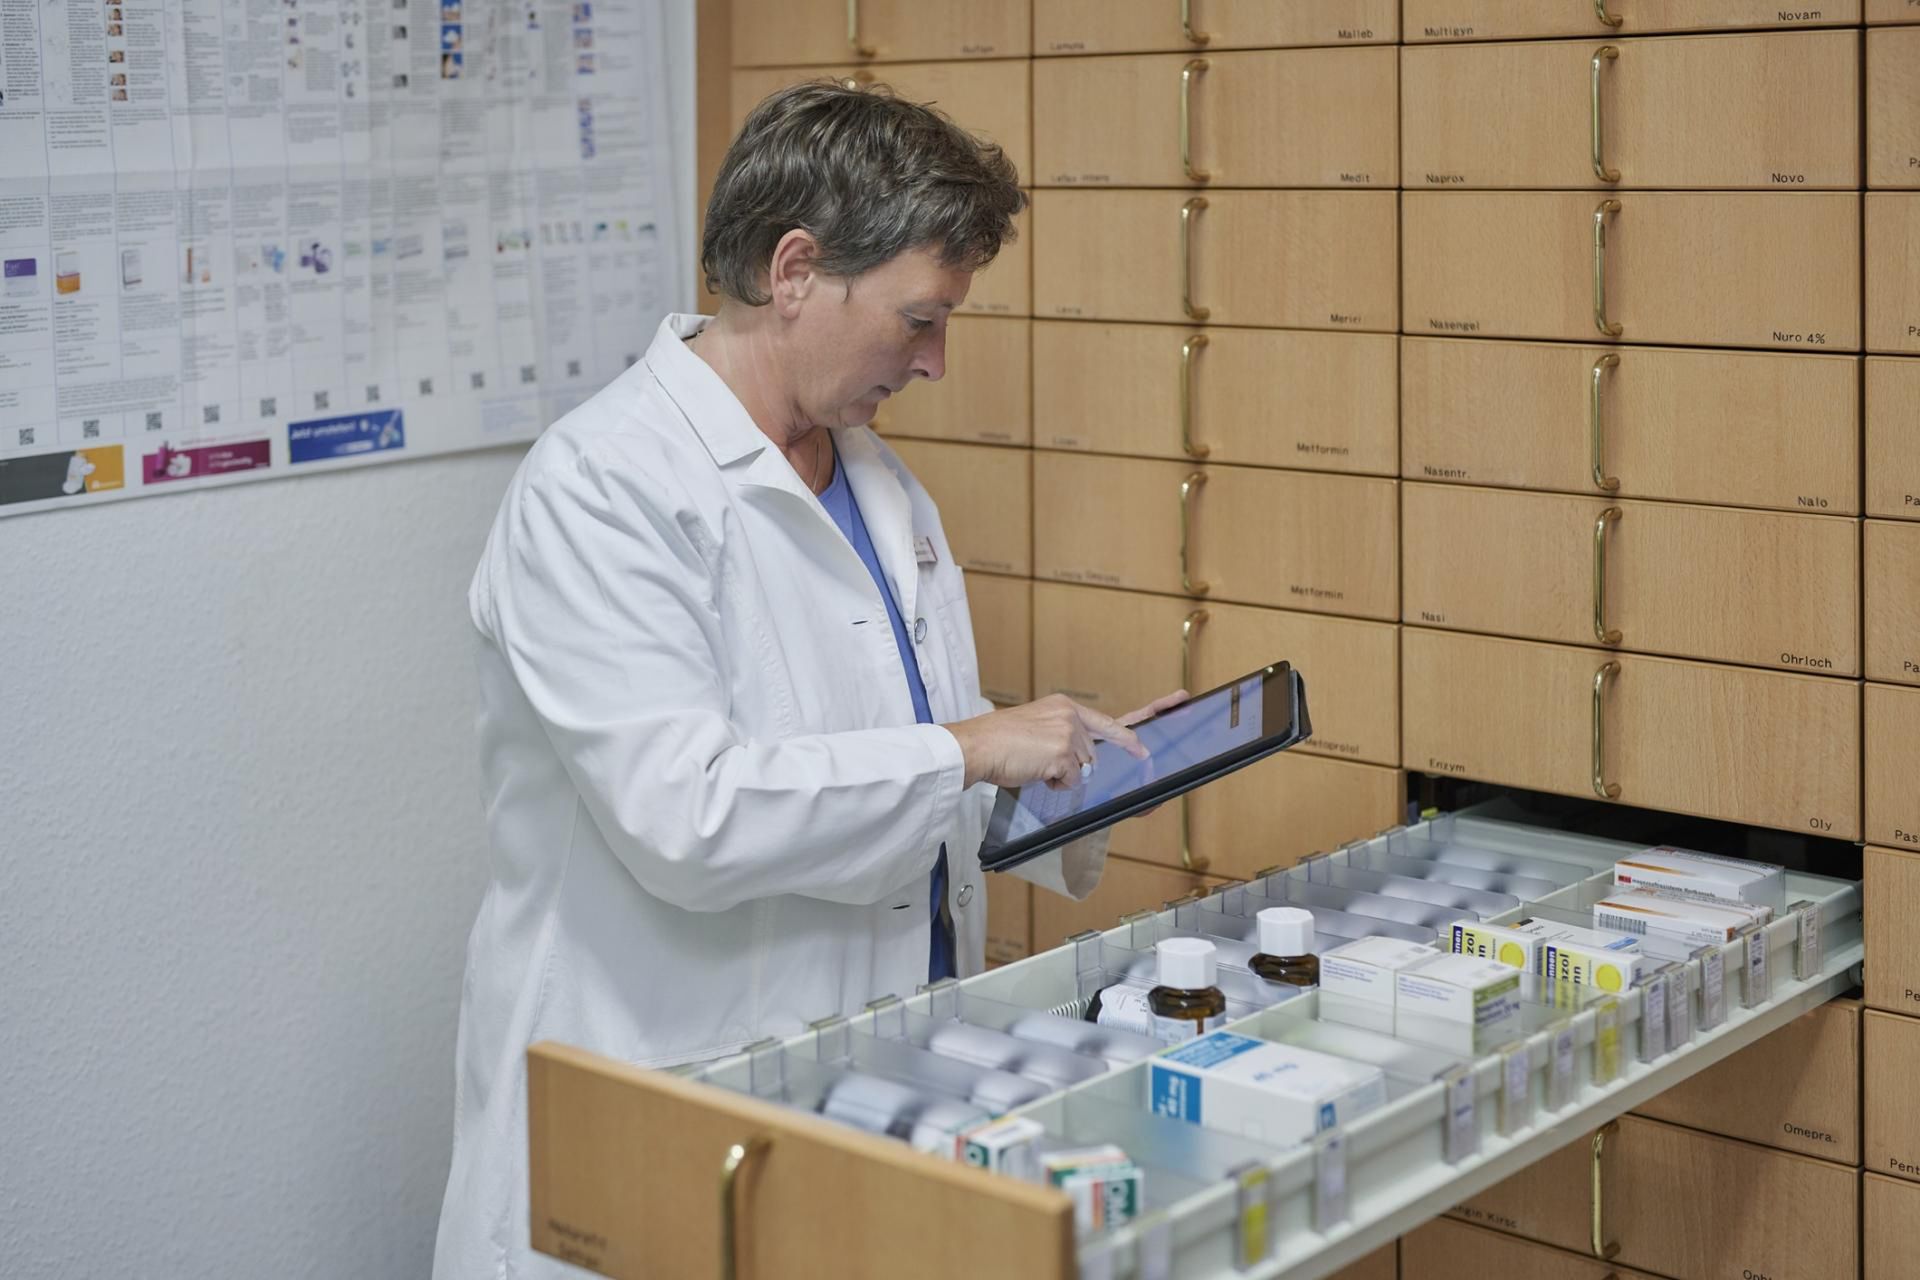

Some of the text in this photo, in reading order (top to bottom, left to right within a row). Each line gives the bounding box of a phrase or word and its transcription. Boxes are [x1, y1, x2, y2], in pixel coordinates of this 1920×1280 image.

[1777, 9, 1822, 21] Novam
[1424, 26, 1474, 38] Multigyn
[1340, 172, 1370, 184] Medit
[1426, 173, 1465, 186] Naprox
[1772, 173, 1804, 184] Novo
[1773, 331, 1826, 345] Nuro 4%
[1296, 442, 1349, 456] Metformin
[1423, 465, 1471, 479] Nasentr.
[1797, 495, 1829, 508] Nalo
[1290, 584, 1344, 601] Metformin
[1422, 611, 1446, 623] Nasi
[1780, 652, 1833, 669] Ohrloch
[1429, 757, 1465, 773] Enzym
[1809, 817, 1832, 832] Oly
[1895, 829, 1919, 843] Pas
[1783, 1122, 1838, 1144] Omepra.
